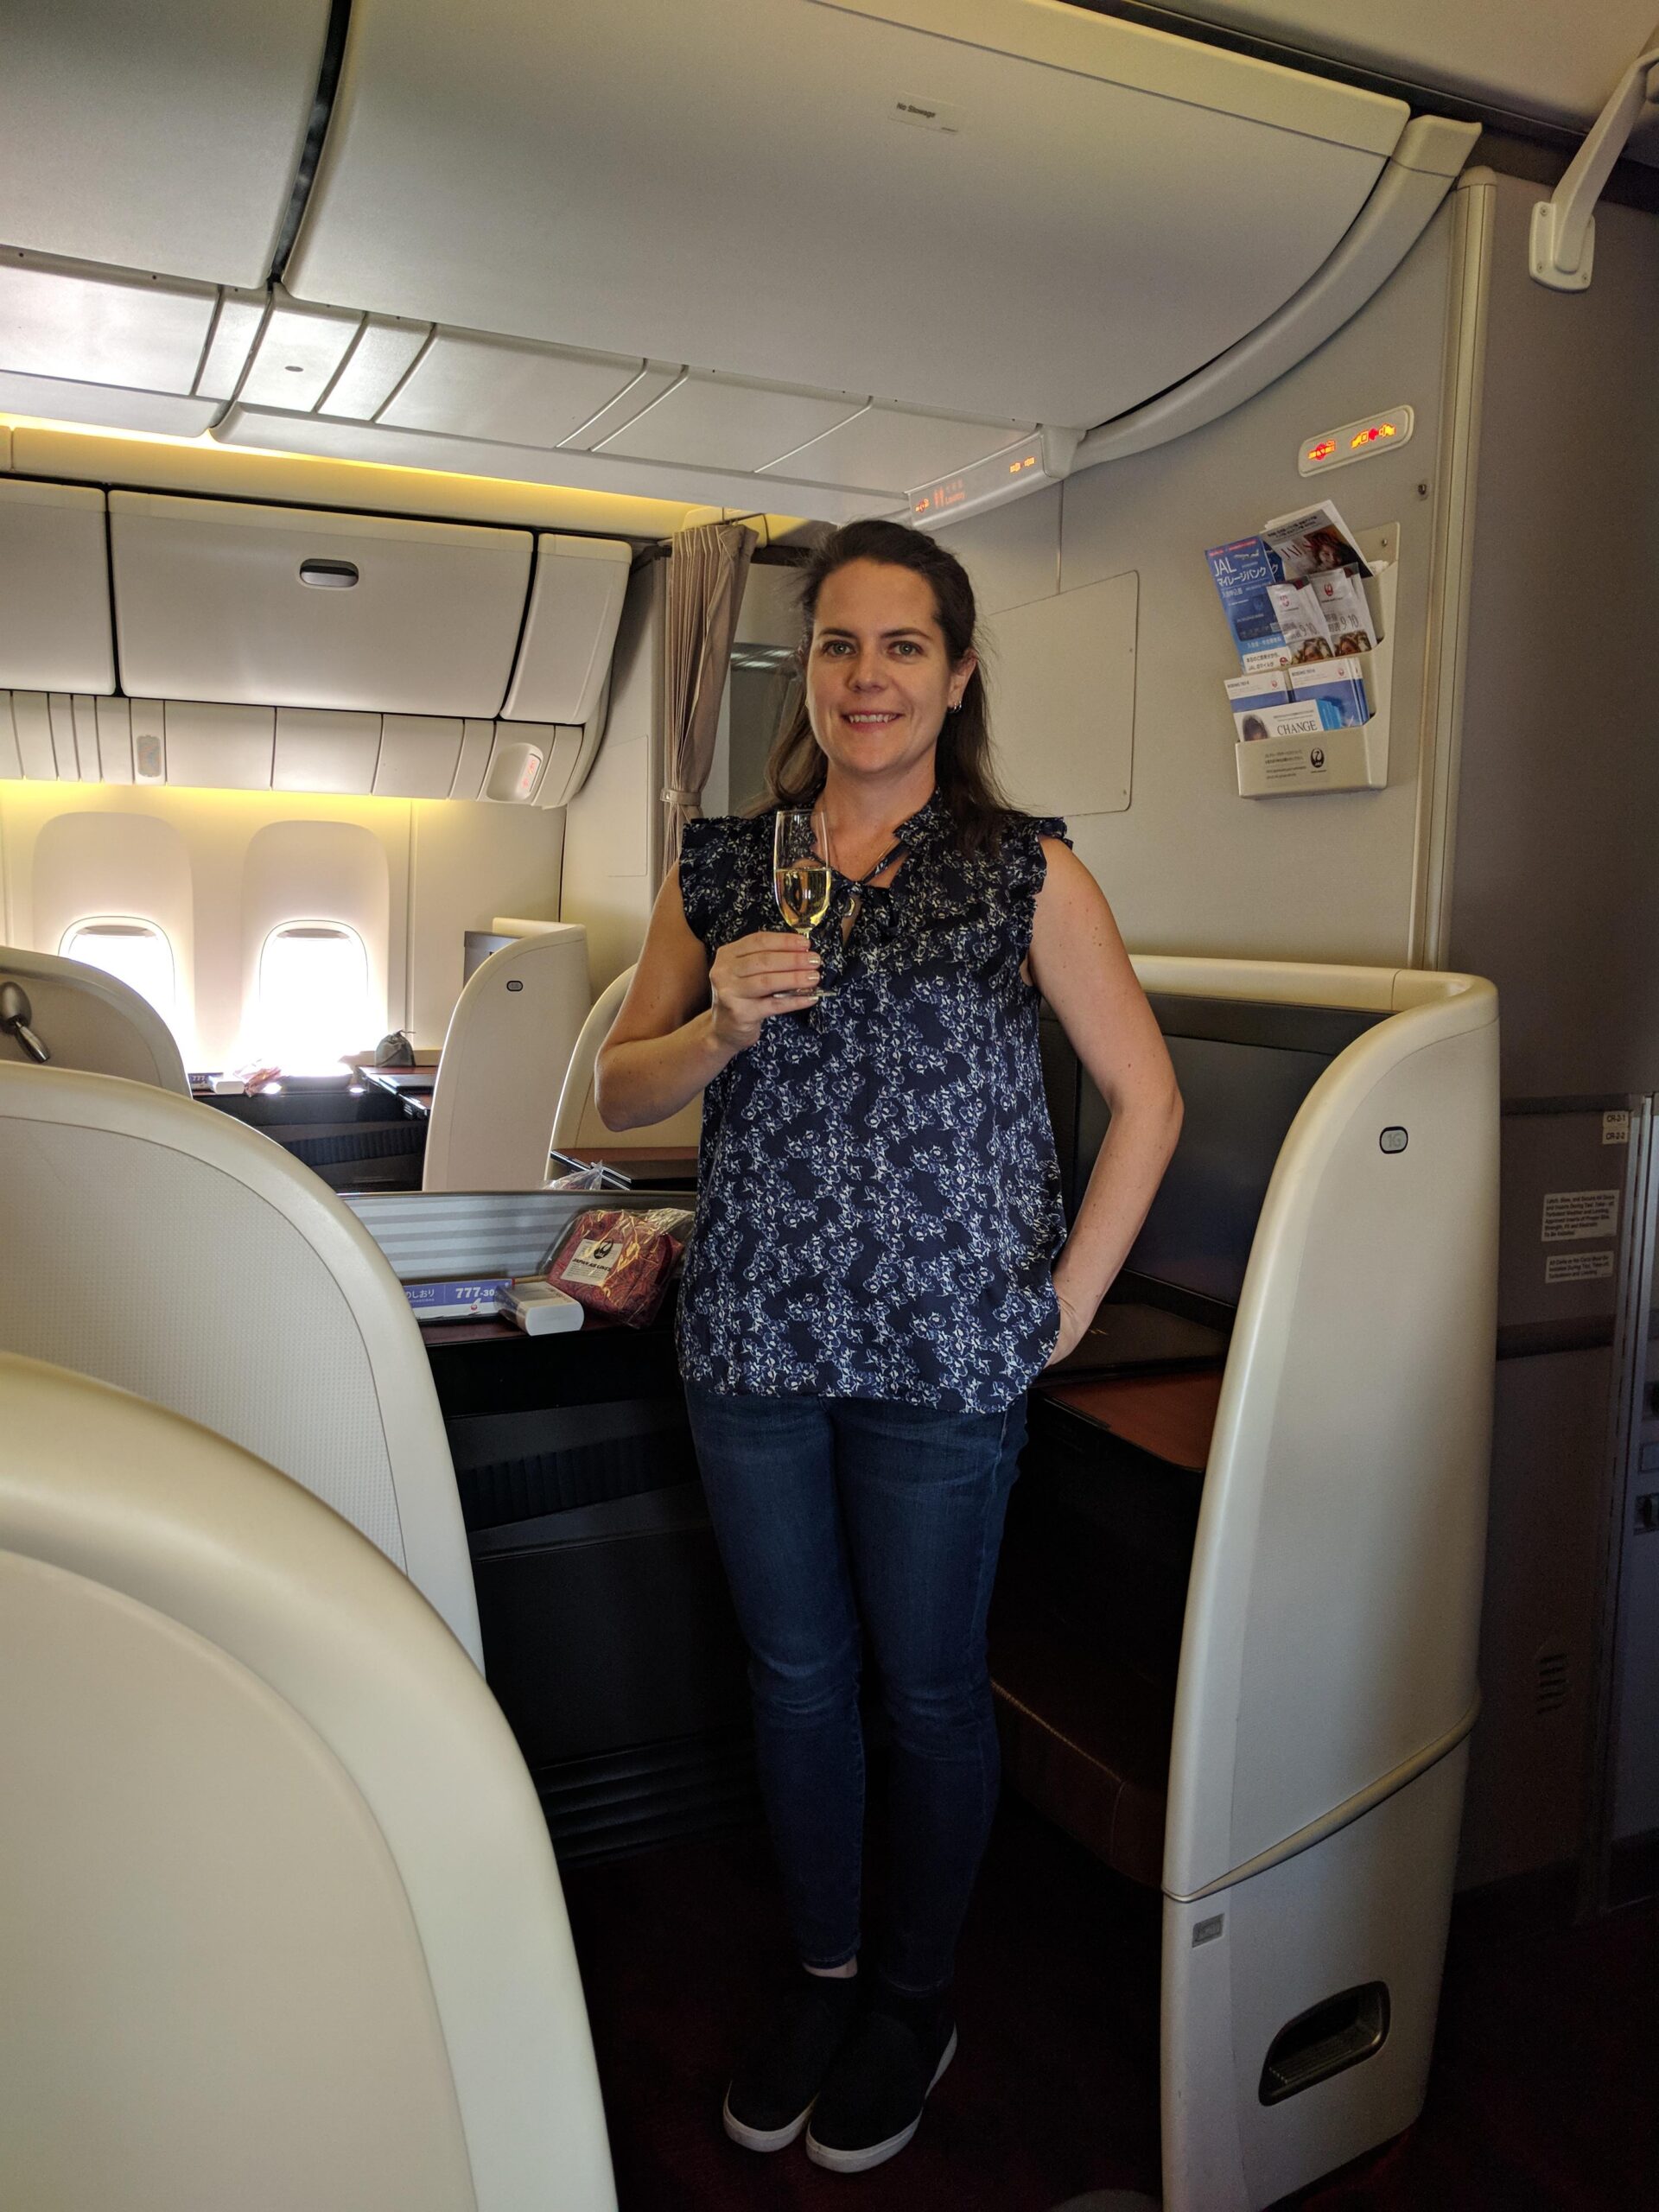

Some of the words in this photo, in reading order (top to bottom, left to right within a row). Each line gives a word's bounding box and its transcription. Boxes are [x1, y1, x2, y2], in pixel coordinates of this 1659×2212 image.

[897, 102, 906, 111] No
[1214, 557, 1236, 577] JAL
[1217, 567, 1266, 586] マイレージバンク
[1277, 720, 1318, 735] CHANGE
[455, 1286, 498, 1299] 777-30
